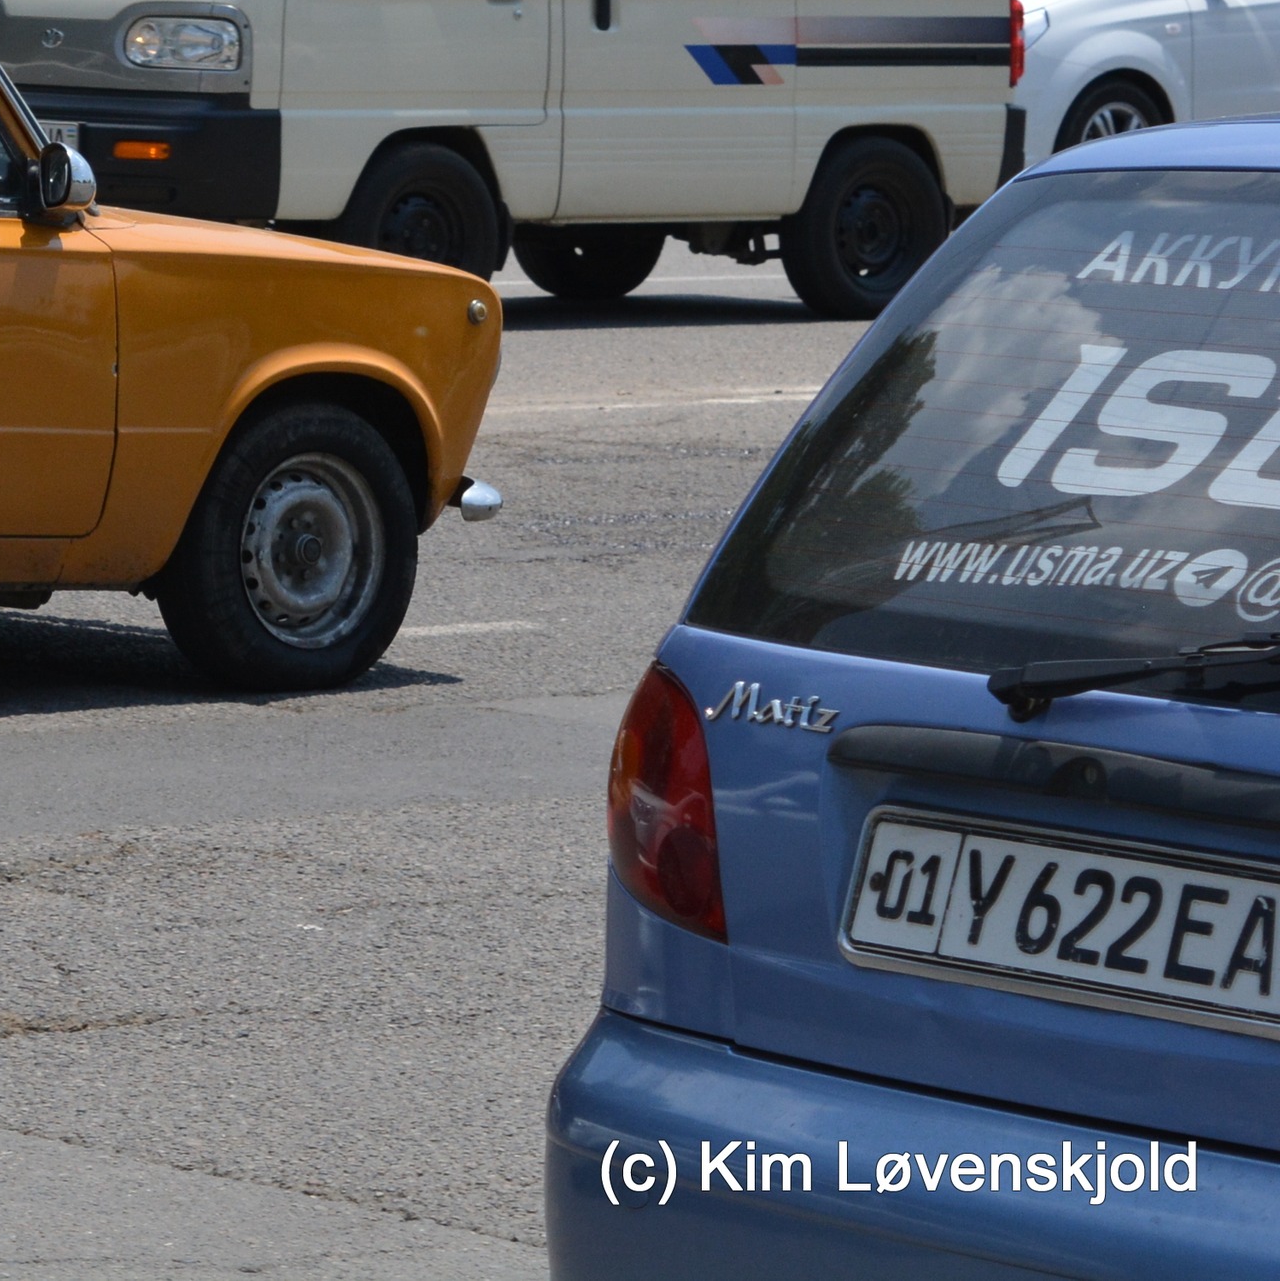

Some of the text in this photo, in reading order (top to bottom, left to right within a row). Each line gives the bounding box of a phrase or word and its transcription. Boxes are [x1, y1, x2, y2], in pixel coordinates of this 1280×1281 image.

[893, 540, 1189, 591] www.usma.uz
[705, 681, 839, 734] Matiz
[874, 849, 941, 927] 01
